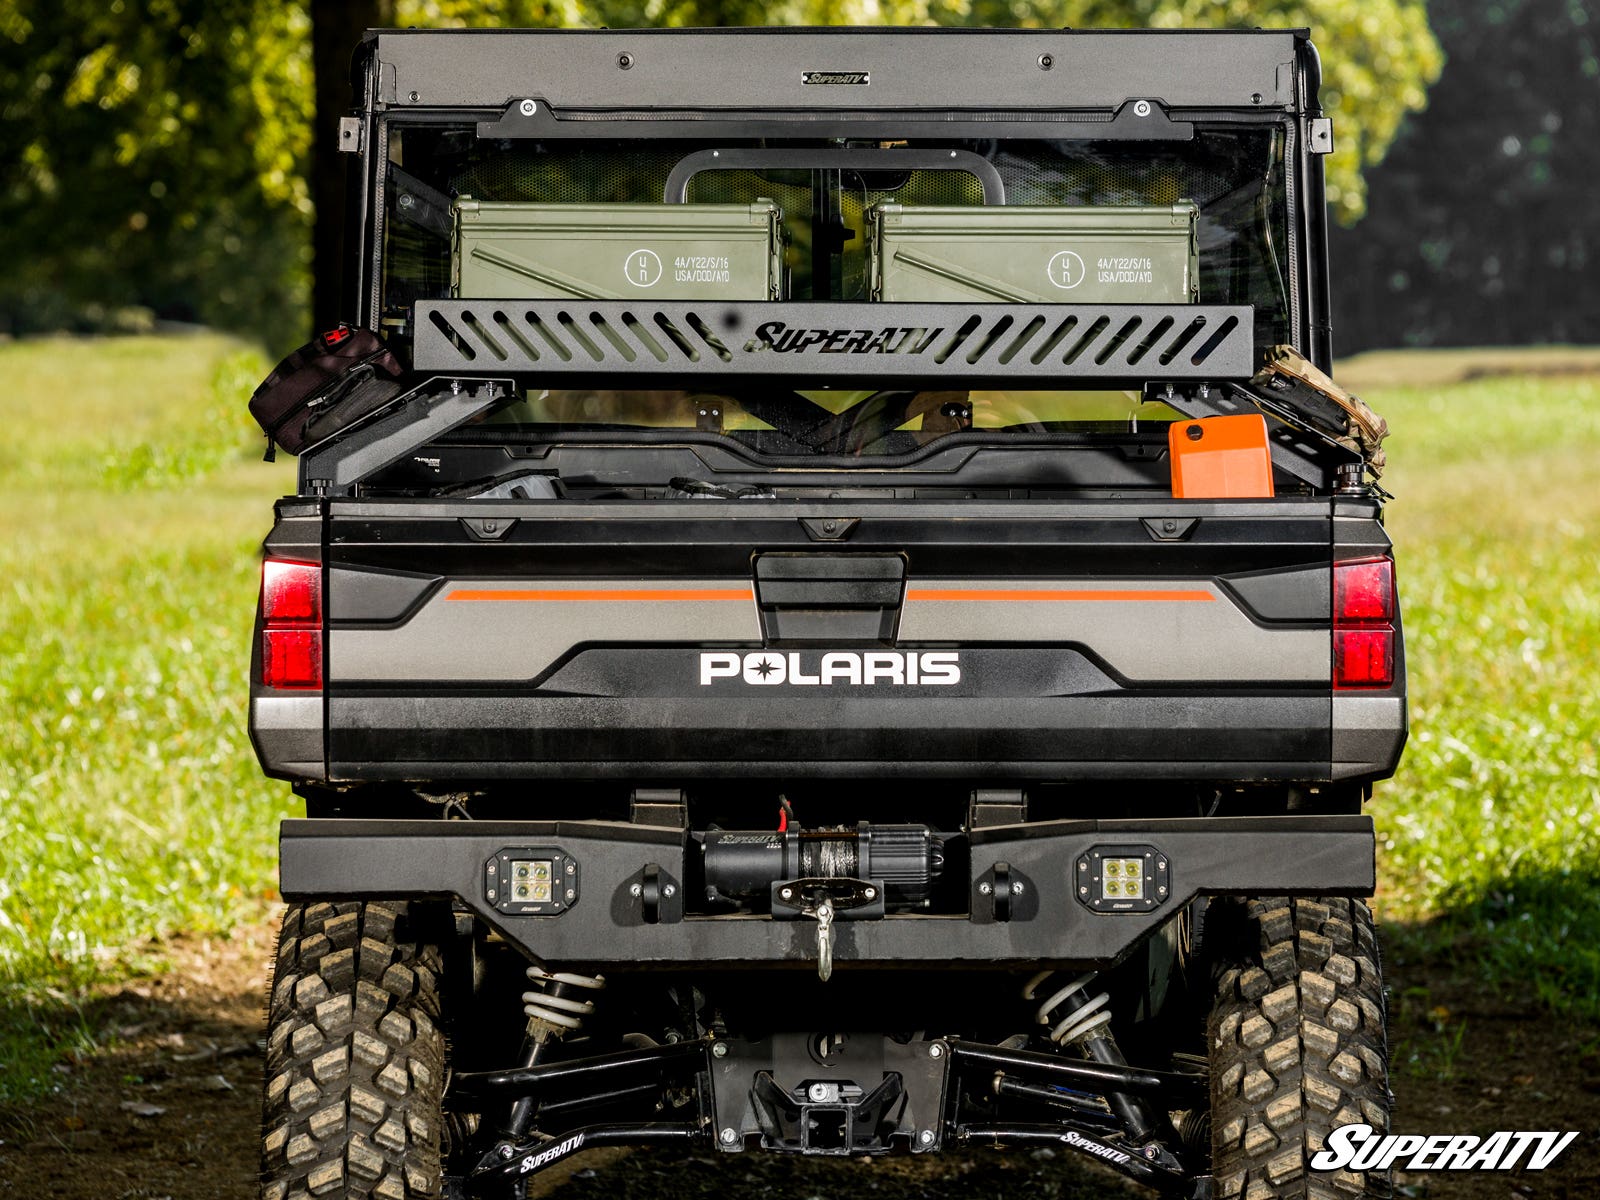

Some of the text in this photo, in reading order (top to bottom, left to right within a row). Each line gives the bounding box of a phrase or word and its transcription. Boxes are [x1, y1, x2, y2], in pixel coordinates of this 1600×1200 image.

[807, 73, 864, 84] SUPERATV
[674, 257, 729, 269] 4A/Y22/S/16
[1097, 258, 1152, 270] 4A/Y22/S/16
[743, 321, 945, 354] SUPERATV
[700, 652, 961, 685] POLARIS
[520, 1132, 584, 1174] SUPERATV
[1060, 1131, 1131, 1164] SUPERATV
